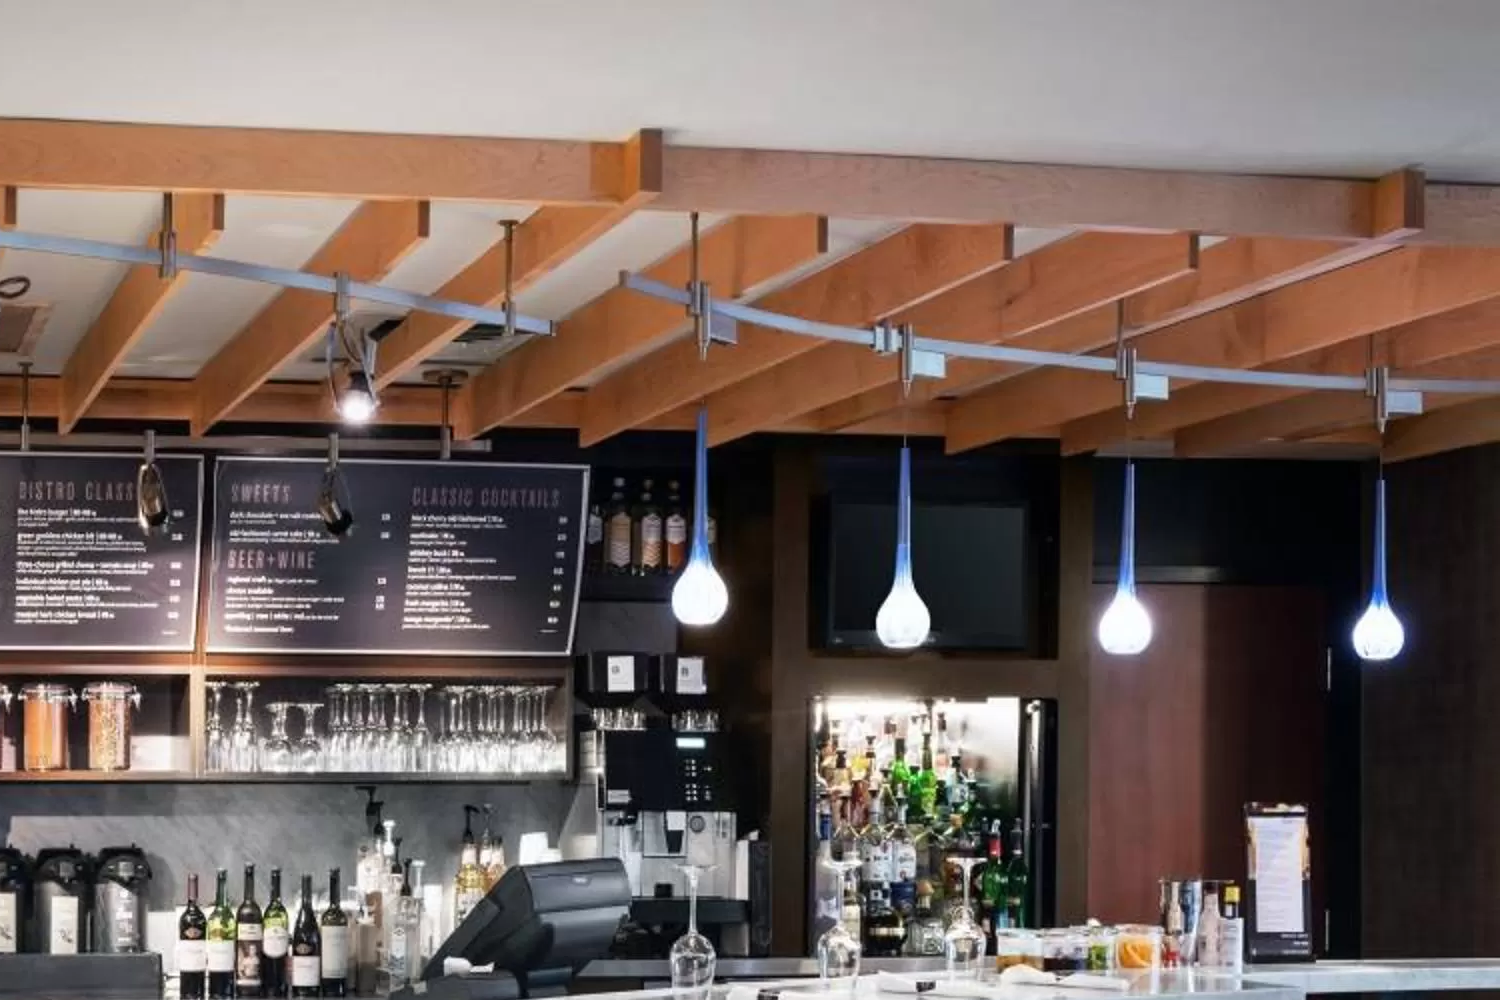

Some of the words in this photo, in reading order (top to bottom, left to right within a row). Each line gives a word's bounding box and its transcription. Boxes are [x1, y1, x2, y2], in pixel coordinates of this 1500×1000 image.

[18, 480, 76, 501] BISTRO
[230, 483, 292, 505] SWEETS
[411, 486, 474, 508] CLASSIC
[480, 488, 561, 509] COCKTAILS
